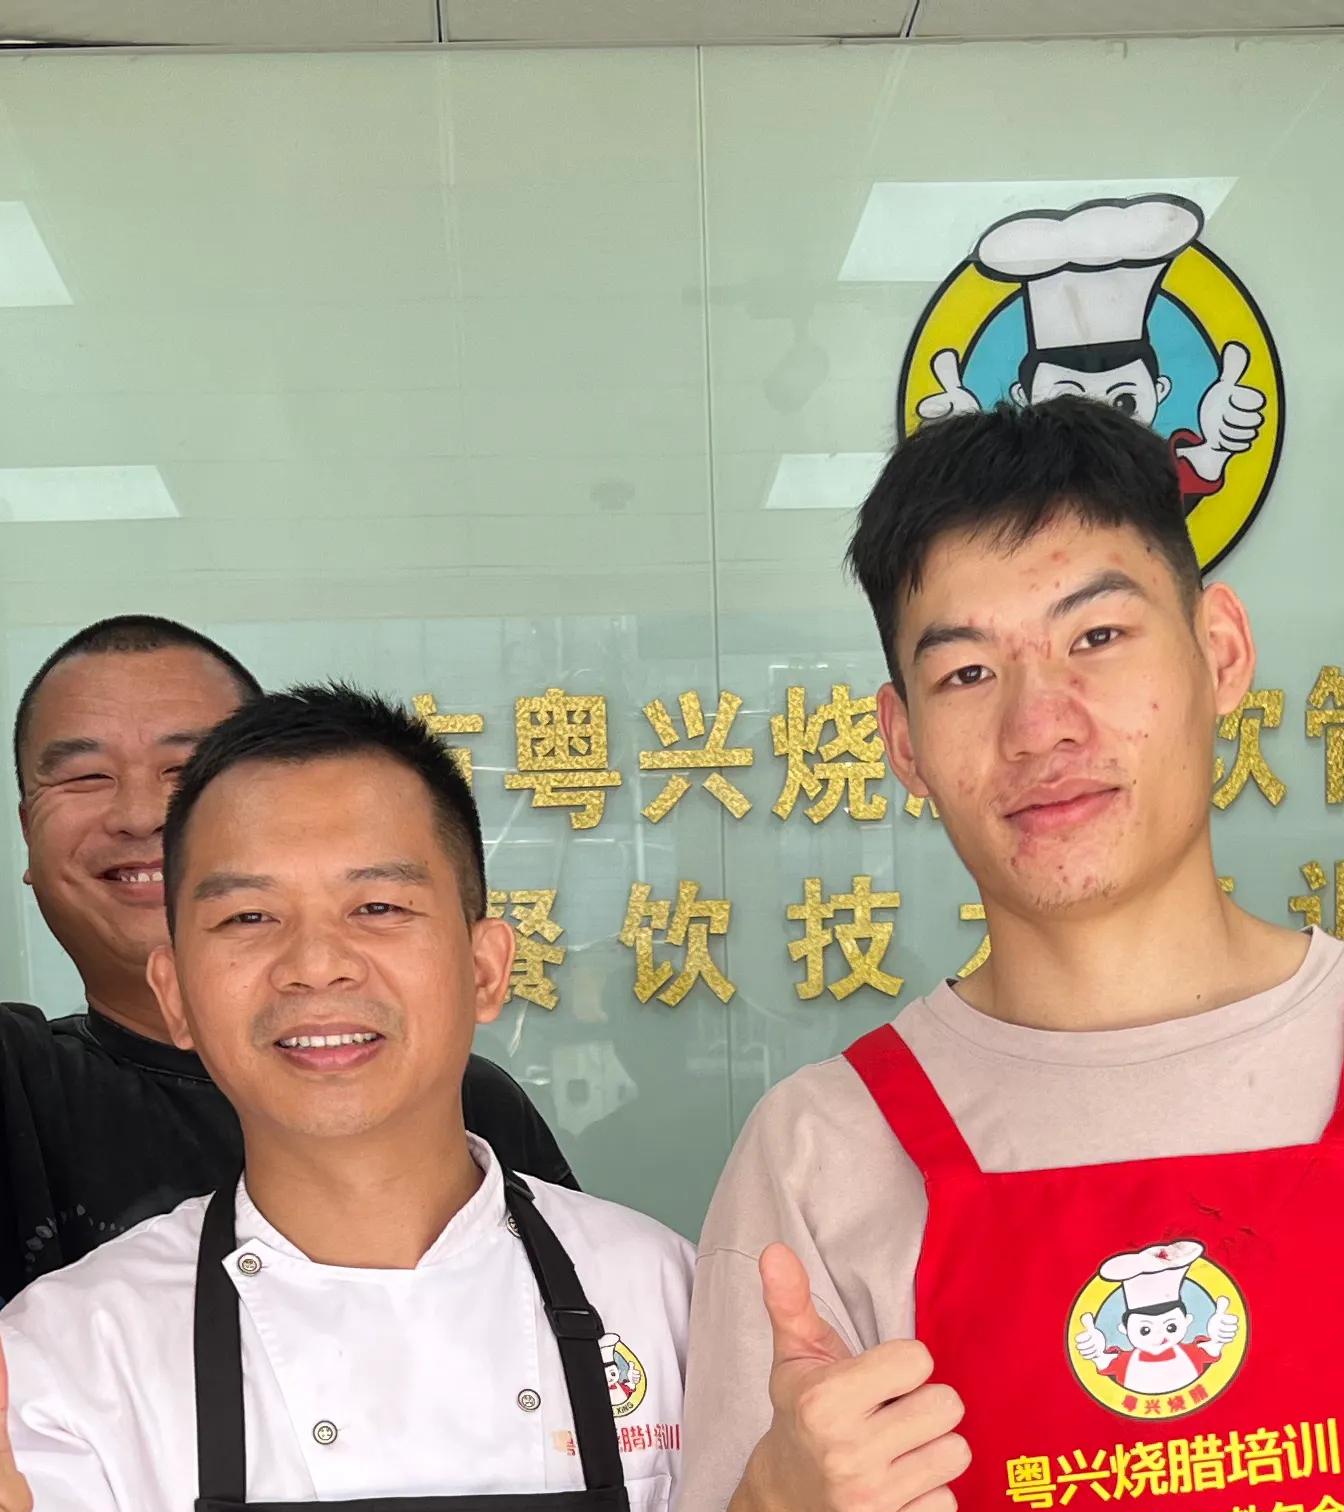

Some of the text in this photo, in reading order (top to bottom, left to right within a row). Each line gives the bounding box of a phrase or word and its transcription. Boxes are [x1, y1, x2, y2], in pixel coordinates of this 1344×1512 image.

[1005, 1418, 1342, 1510] 粤兴烧腊培训
